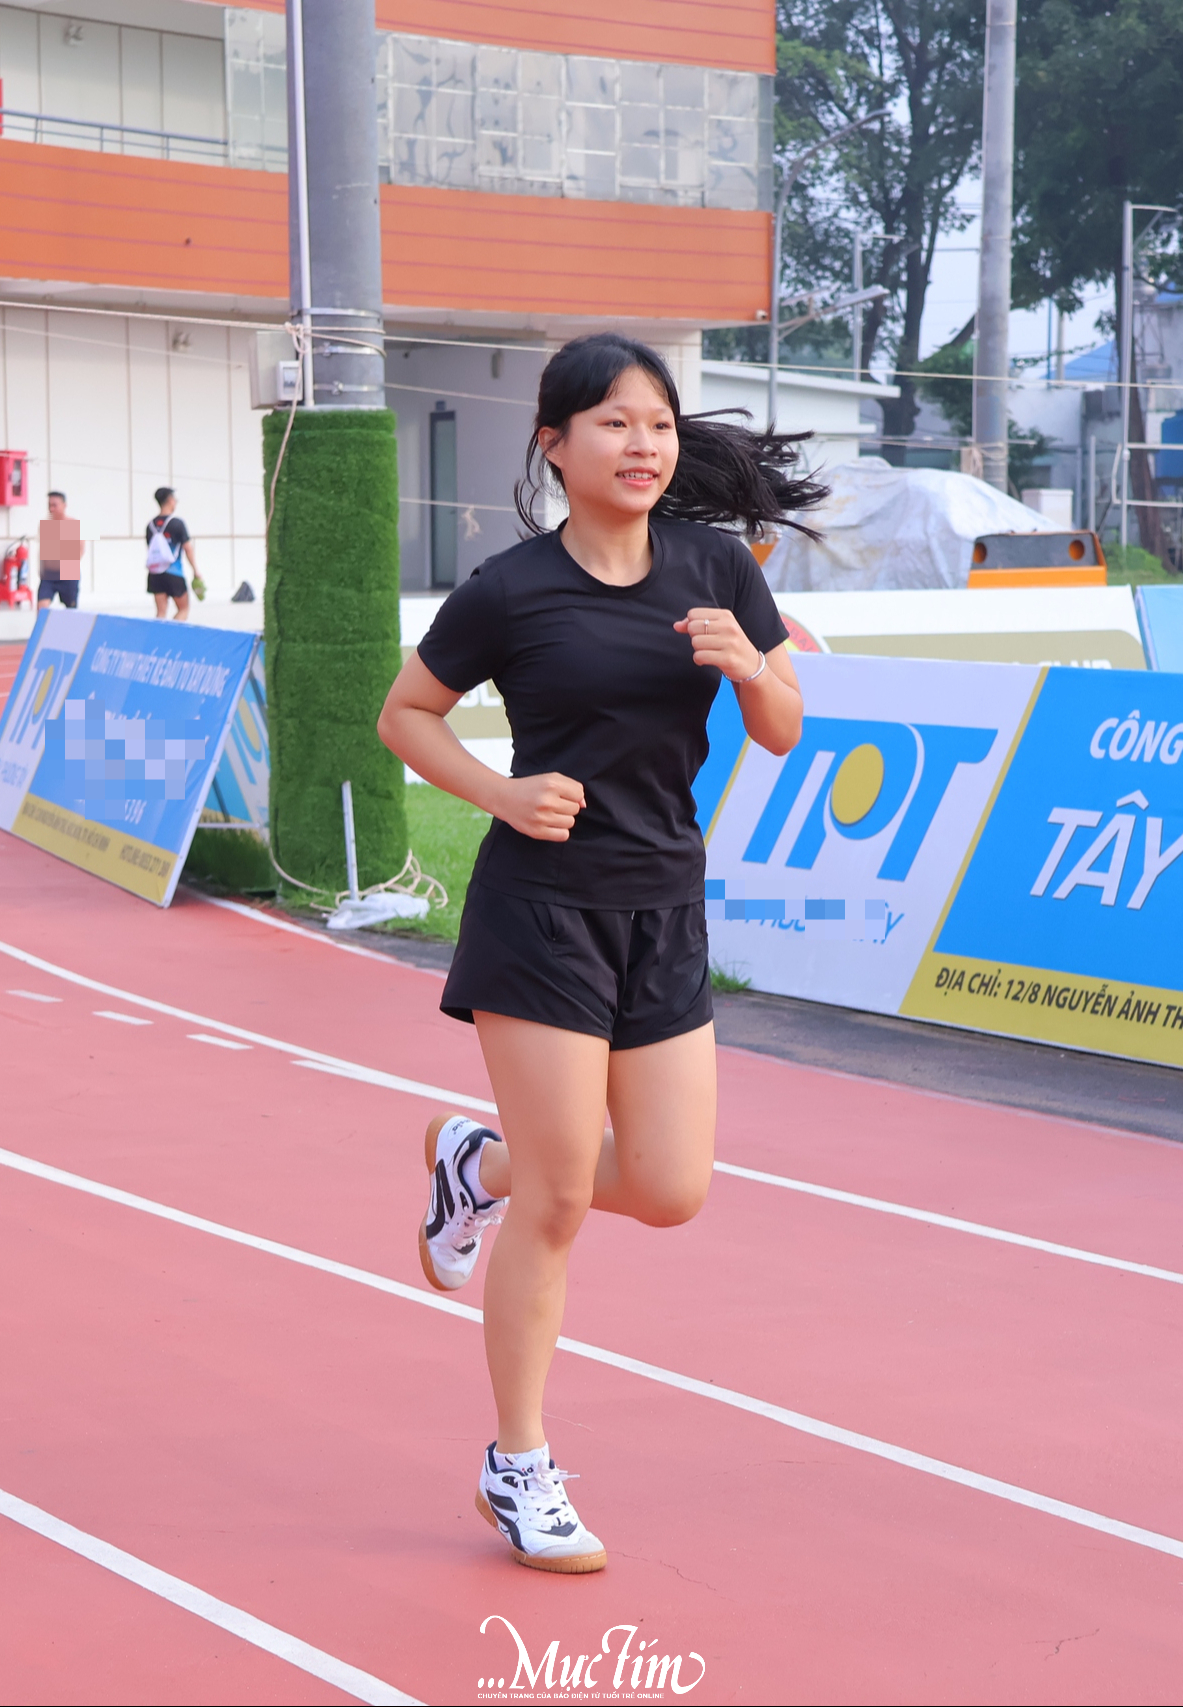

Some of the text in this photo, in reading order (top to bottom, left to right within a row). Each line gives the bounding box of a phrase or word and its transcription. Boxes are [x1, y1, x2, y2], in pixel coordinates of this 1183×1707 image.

[1090, 709, 1183, 765] CÔNG
[1029, 789, 1183, 910] TÂY
[935, 967, 965, 996] ĐỊA
[967, 968, 1002, 998] CHỈ:
[1004, 979, 1041, 1004] 12/8
[1041, 983, 1119, 1018] NGUYỄN
[1116, 990, 1162, 1025] ẢNH
